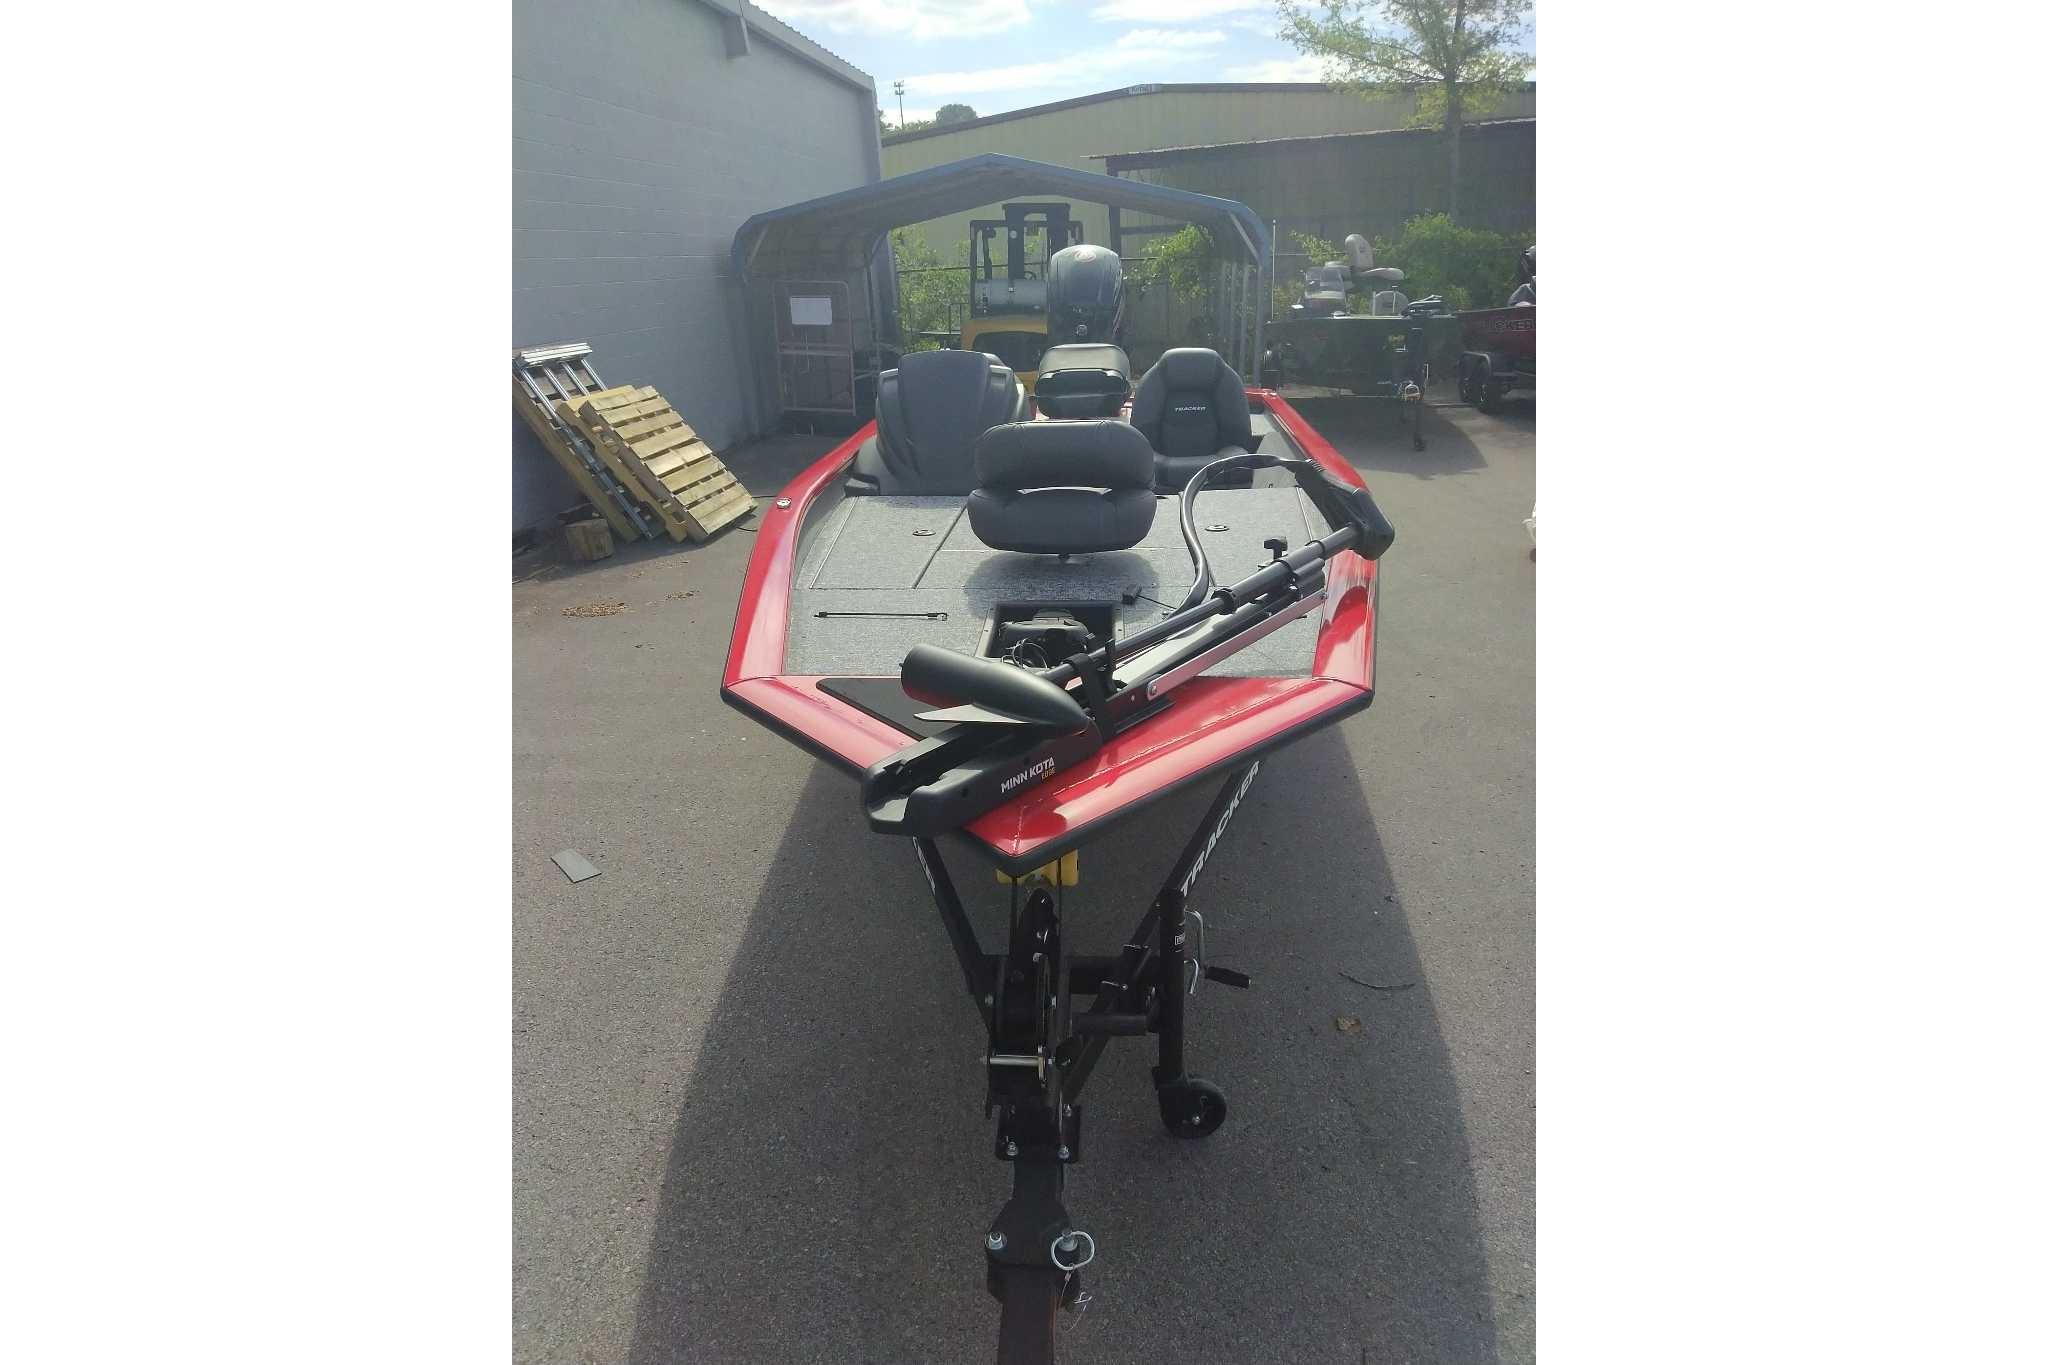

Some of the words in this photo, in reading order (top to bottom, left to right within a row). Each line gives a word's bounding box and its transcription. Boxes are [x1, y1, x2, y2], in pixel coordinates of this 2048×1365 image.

[1001, 770, 1028, 793] MINN
[1029, 757, 1055, 778] KOTA
[1180, 760, 1260, 897] TRACKER
